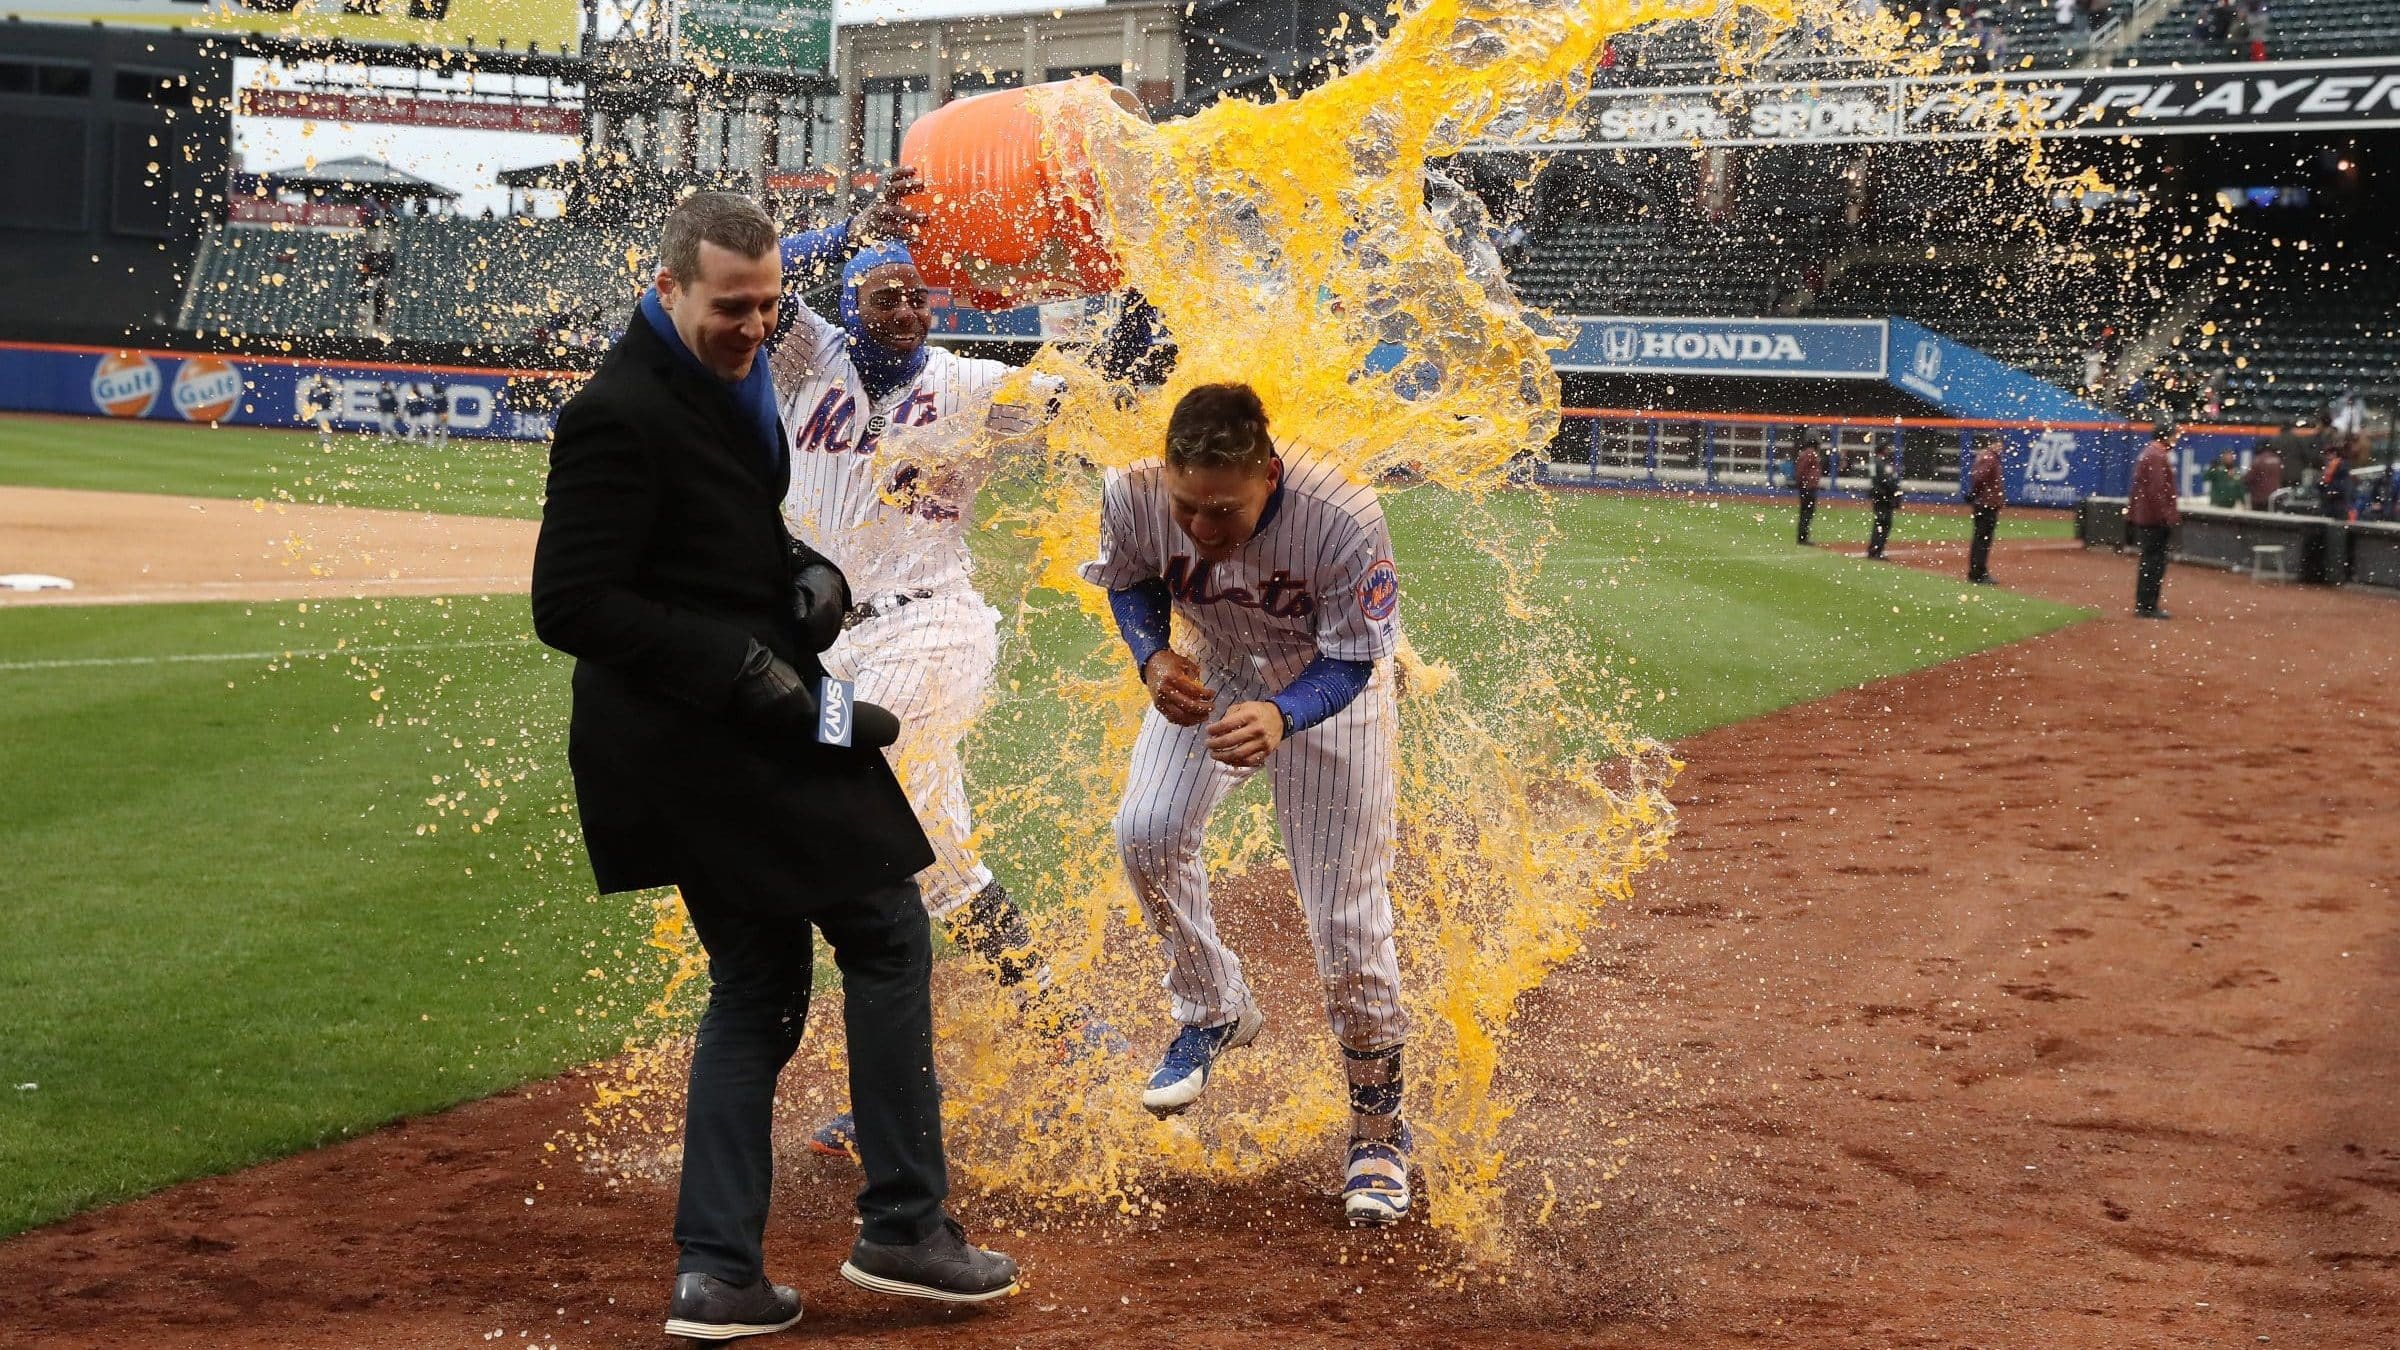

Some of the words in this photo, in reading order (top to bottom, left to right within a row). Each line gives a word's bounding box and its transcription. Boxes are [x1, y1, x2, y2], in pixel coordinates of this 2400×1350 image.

[1641, 333, 1805, 360] HONDA
[97, 366, 154, 400] Gulf
[178, 375, 235, 407] Gulf
[1162, 555, 1315, 618] Mets
[825, 679, 849, 744] SNY
